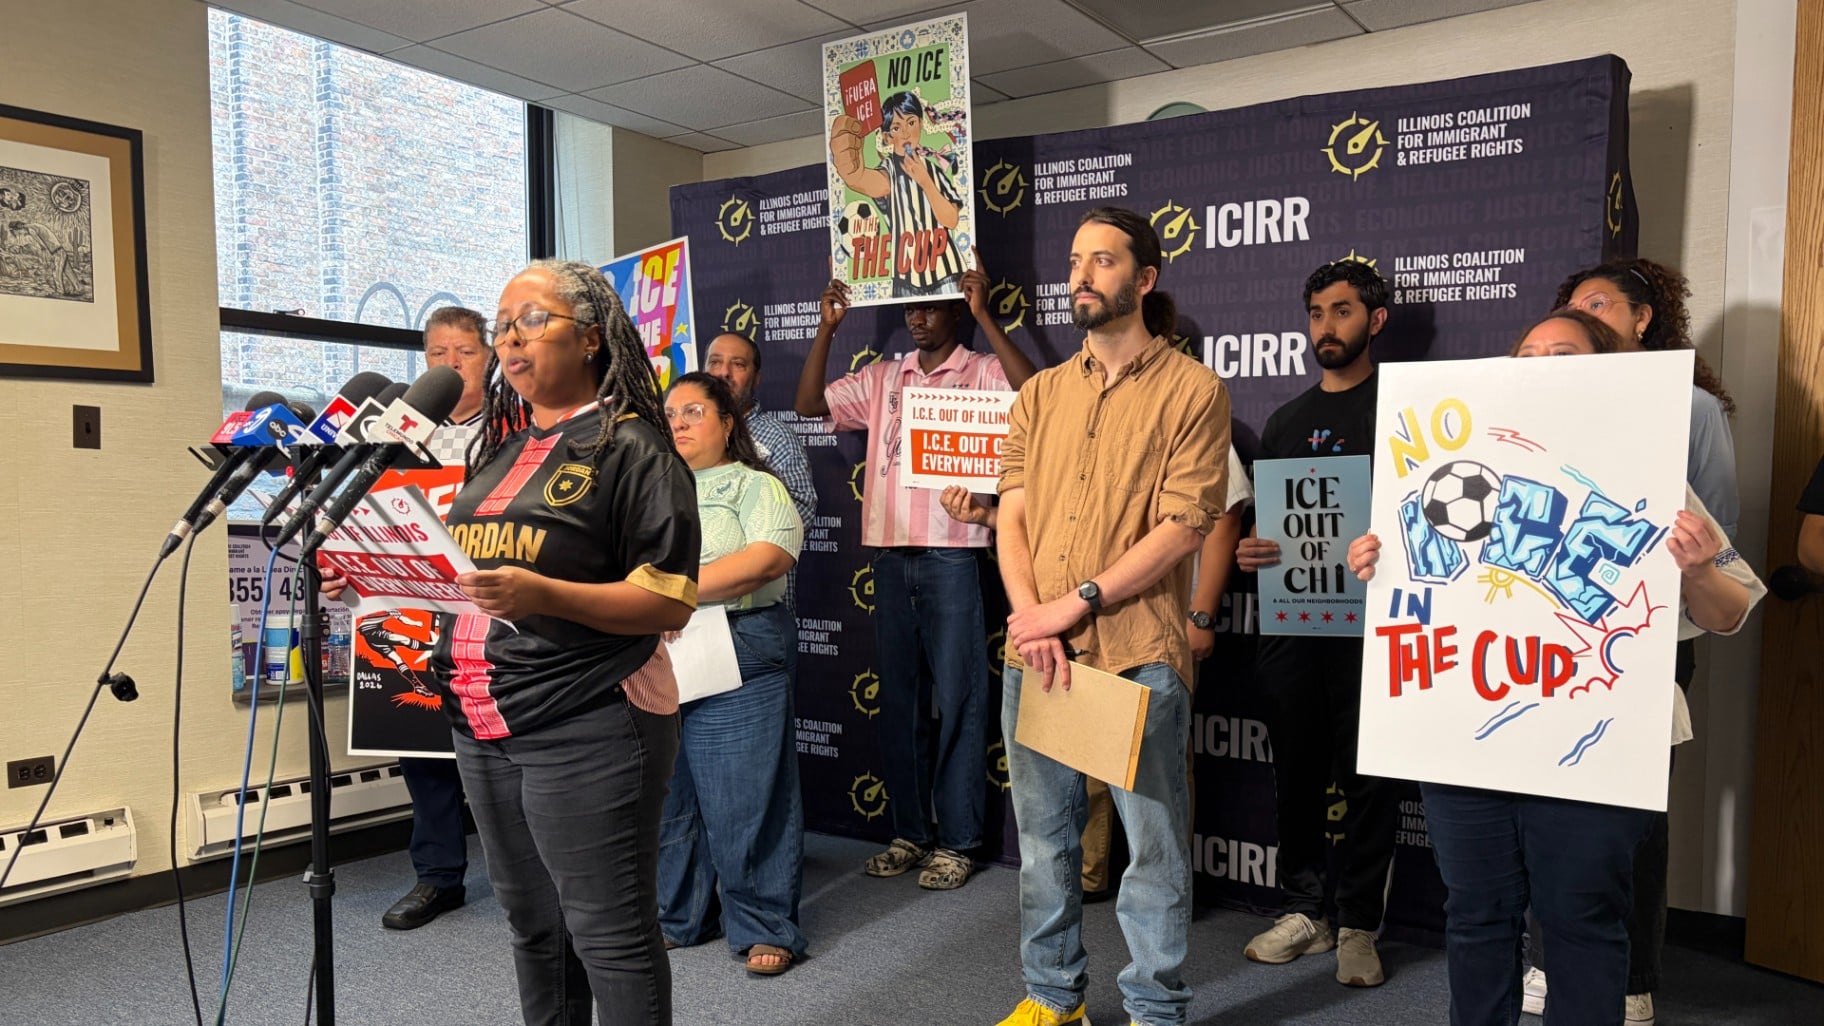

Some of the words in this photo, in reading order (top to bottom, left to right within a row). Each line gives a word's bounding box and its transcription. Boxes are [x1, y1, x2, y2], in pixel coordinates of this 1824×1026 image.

[887, 55, 911, 89] NO
[916, 48, 944, 83] ICE
[845, 78, 876, 106] ¡FUERA
[856, 100, 873, 121] ICE!
[1398, 113, 1454, 133] ILLINOIS
[1457, 103, 1531, 126] COALITION
[1397, 133, 1423, 150] FOR
[1427, 123, 1507, 147] IMMIGRANT
[1397, 151, 1406, 166] &
[1409, 145, 1467, 165] REFUGEE
[1471, 138, 1523, 159] RIGHTS
[1034, 160, 1076, 176] ILLINOIS
[1077, 153, 1132, 172] COALITION
[1034, 177, 1054, 191] FOR
[1056, 170, 1116, 189] IMMIGRANT
[759, 195, 791, 210] ILLINOIS
[792, 189, 829, 205] COALITIO
[1035, 192, 1042, 205] &
[1044, 188, 1087, 204] REFUGEE
[1089, 183, 1128, 200] RIGHTS
[759, 211, 775, 224] FOR
[776, 203, 821, 221] IMMIGRANT
[1205, 196, 1310, 249] ICIRR
[760, 225, 767, 236] &
[767, 221, 800, 235] REFUGEE
[853, 219, 863, 235] IN
[852, 233, 892, 280] THE
[897, 228, 948, 275] CUP
[1395, 254, 1449, 271] ILLINOIS
[1452, 248, 1525, 268] COALITION
[630, 248, 680, 317] ICE
[1394, 272, 1419, 288] FOR
[1423, 267, 1501, 287] IMMIGRANT
[1036, 283, 1071, 296] ILLINOI
[1394, 289, 1403, 304] &
[1405, 287, 1462, 303] REFUGEE
[1466, 283, 1517, 300] RIGHTS
[764, 303, 796, 316] ILLINOIS
[797, 301, 821, 313] COALI
[1036, 298, 1055, 311] FOR
[764, 317, 779, 328] FOR
[781, 314, 821, 327] IMMIGRAN
[1036, 313, 1043, 326] &
[1045, 312, 1074, 325] REFU
[635, 318, 661, 346] HE
[765, 330, 771, 341] &
[771, 329, 804, 341] REFUGEE
[1203, 331, 1307, 379] ICIRR
[912, 407, 936, 421] I.C.E.
[939, 409, 959, 422] OUT
[961, 410, 975, 423] OF
[978, 411, 1010, 425] ILLIN
[269, 421, 287, 437] abc
[1388, 398, 1472, 479] NO
[808, 435, 838, 447] RIGHTS
[923, 432, 954, 452] I.C.E.
[958, 436, 989, 454] OUT
[993, 438, 1003, 455] O
[922, 453, 1001, 475] EVERYWHER
[1285, 476, 1340, 510] ICE
[361, 522, 429, 543] ILLINOIS
[814, 516, 841, 528] ALITION
[1283, 513, 1344, 539] OUT
[448, 521, 547, 564] ORDAN
[810, 541, 838, 553] RIGHTS
[1301, 541, 1330, 561] OF
[371, 557, 417, 577] OUT
[409, 559, 444, 580] OF
[1283, 563, 1345, 594] CHI
[350, 575, 472, 600] EVERYWHER
[1389, 588, 1432, 625] IN
[802, 618, 842, 632] COALITION
[810, 644, 838, 656] RIGHTS
[1375, 624, 1459, 698] THE
[1471, 629, 1579, 702] CUP
[357, 672, 381, 681] DALLAS
[360, 681, 382, 689] 2026
[796, 730, 829, 744] MIGRANT
[803, 720, 842, 734] COALITION
[1194, 713, 1273, 763] ICIR
[810, 745, 838, 758] RIGHTS
